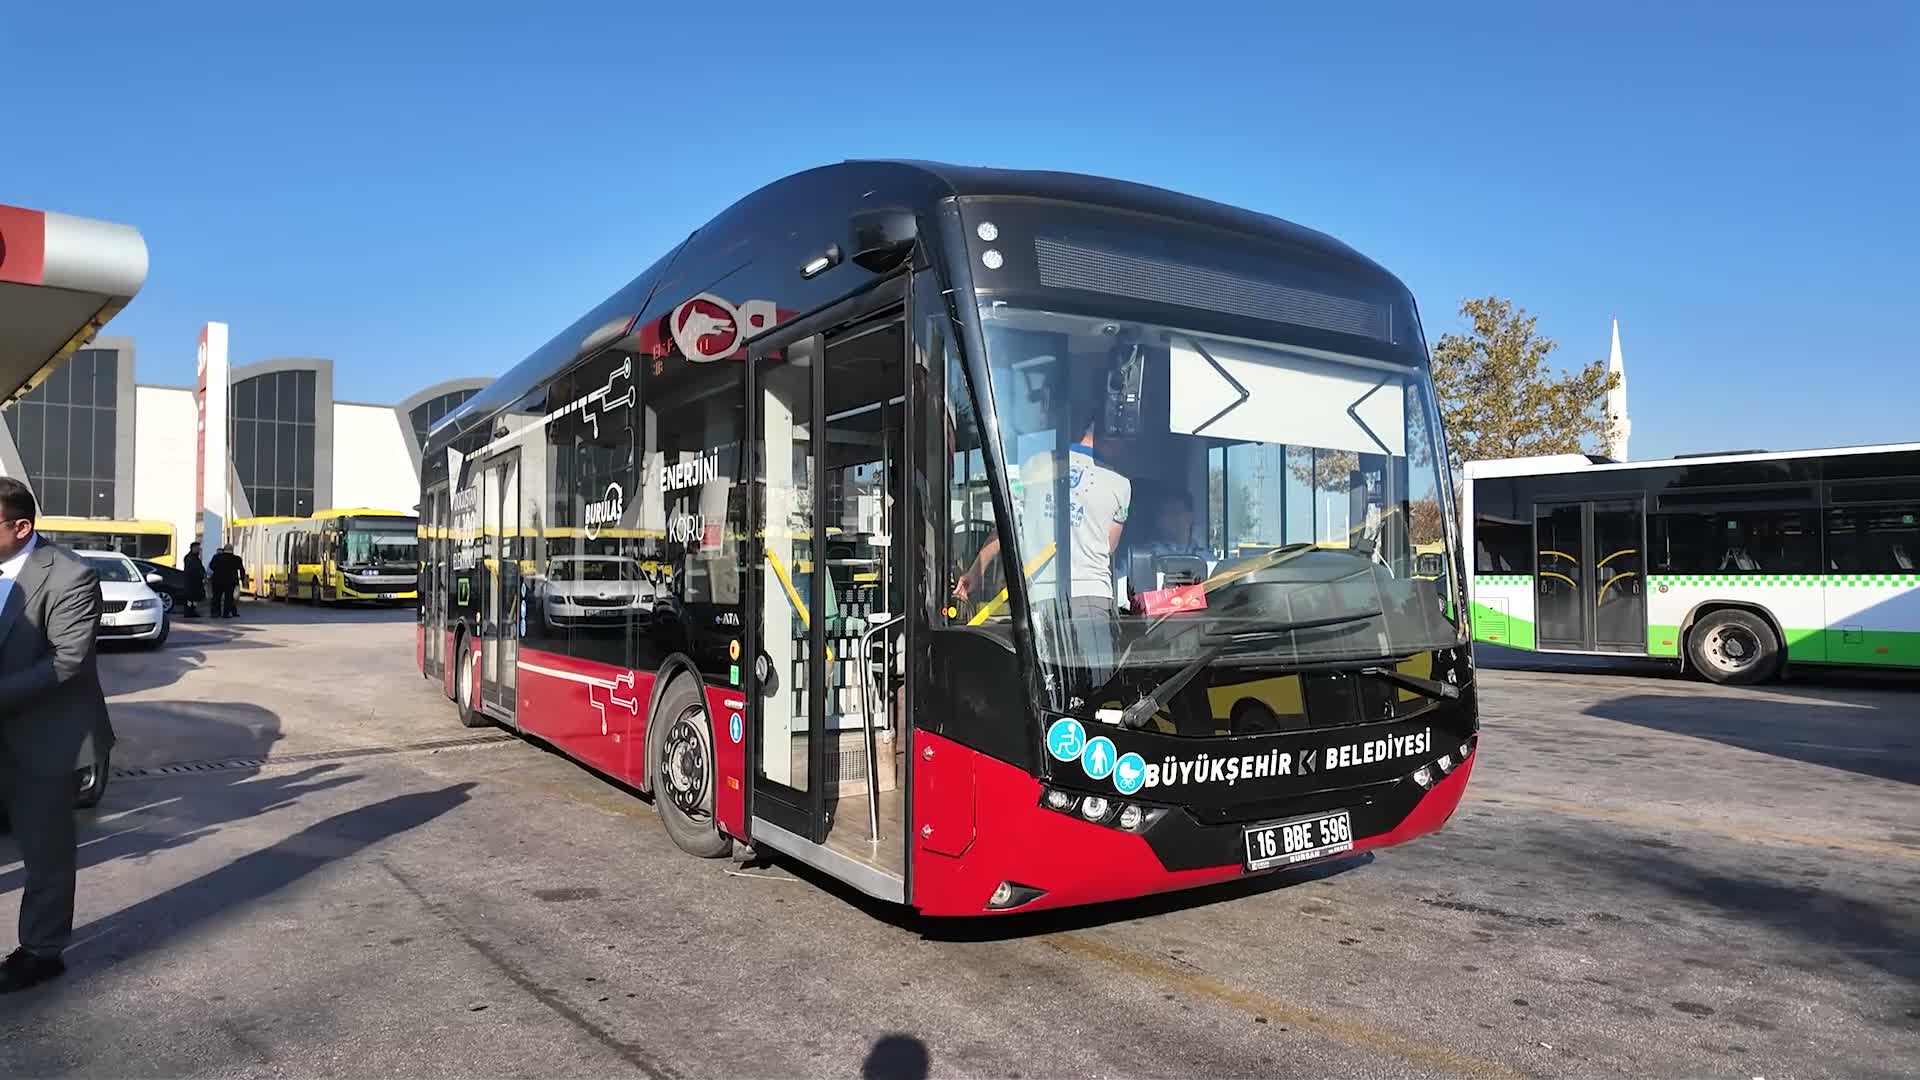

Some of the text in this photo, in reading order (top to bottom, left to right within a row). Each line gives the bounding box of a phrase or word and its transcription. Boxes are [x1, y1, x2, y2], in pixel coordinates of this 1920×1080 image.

[660, 446, 718, 492] ENERJİNİ
[585, 498, 623, 525] BURULAŞ
[669, 514, 705, 543] KORU
[1145, 727, 1431, 787] BÜYÜKŞEHİR BELEDİYESİ
[1257, 830, 1277, 857] 16
[1283, 823, 1314, 853] BBE
[1320, 816, 1348, 844] 596
